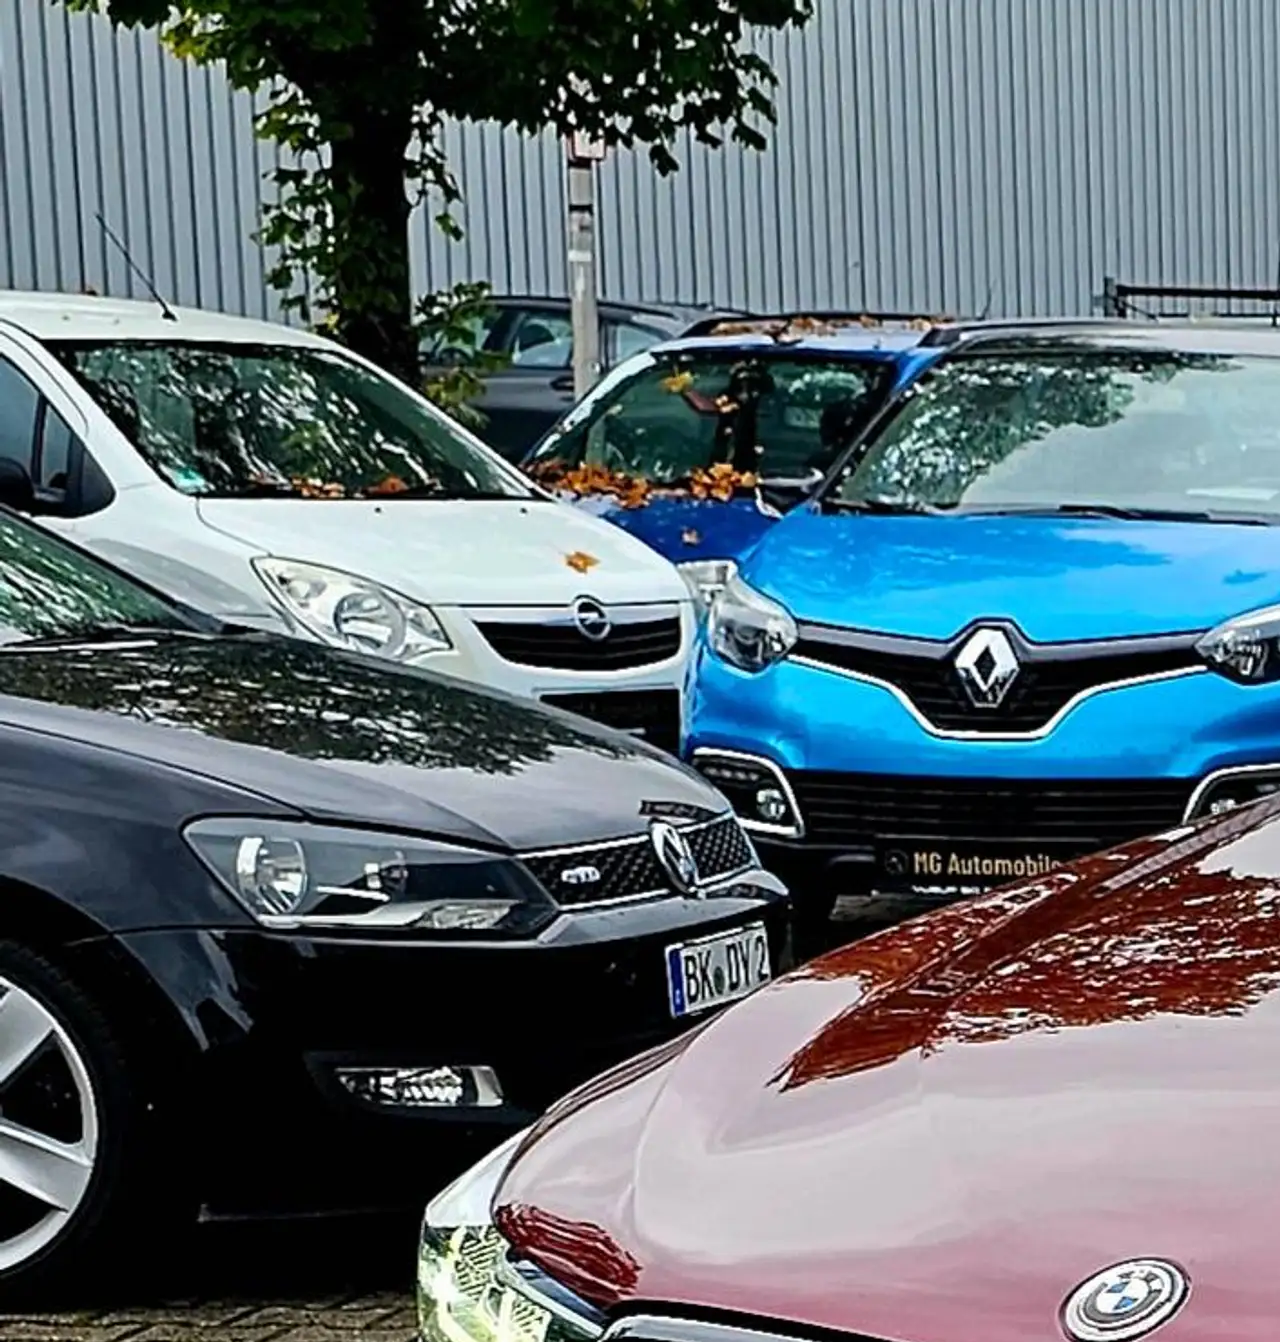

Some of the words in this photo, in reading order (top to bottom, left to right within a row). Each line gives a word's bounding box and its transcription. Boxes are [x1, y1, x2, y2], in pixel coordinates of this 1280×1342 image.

[913, 851, 942, 875] MG
[684, 949, 714, 1005] BK
[726, 938, 751, 992] DY
[755, 934, 769, 982] 2
